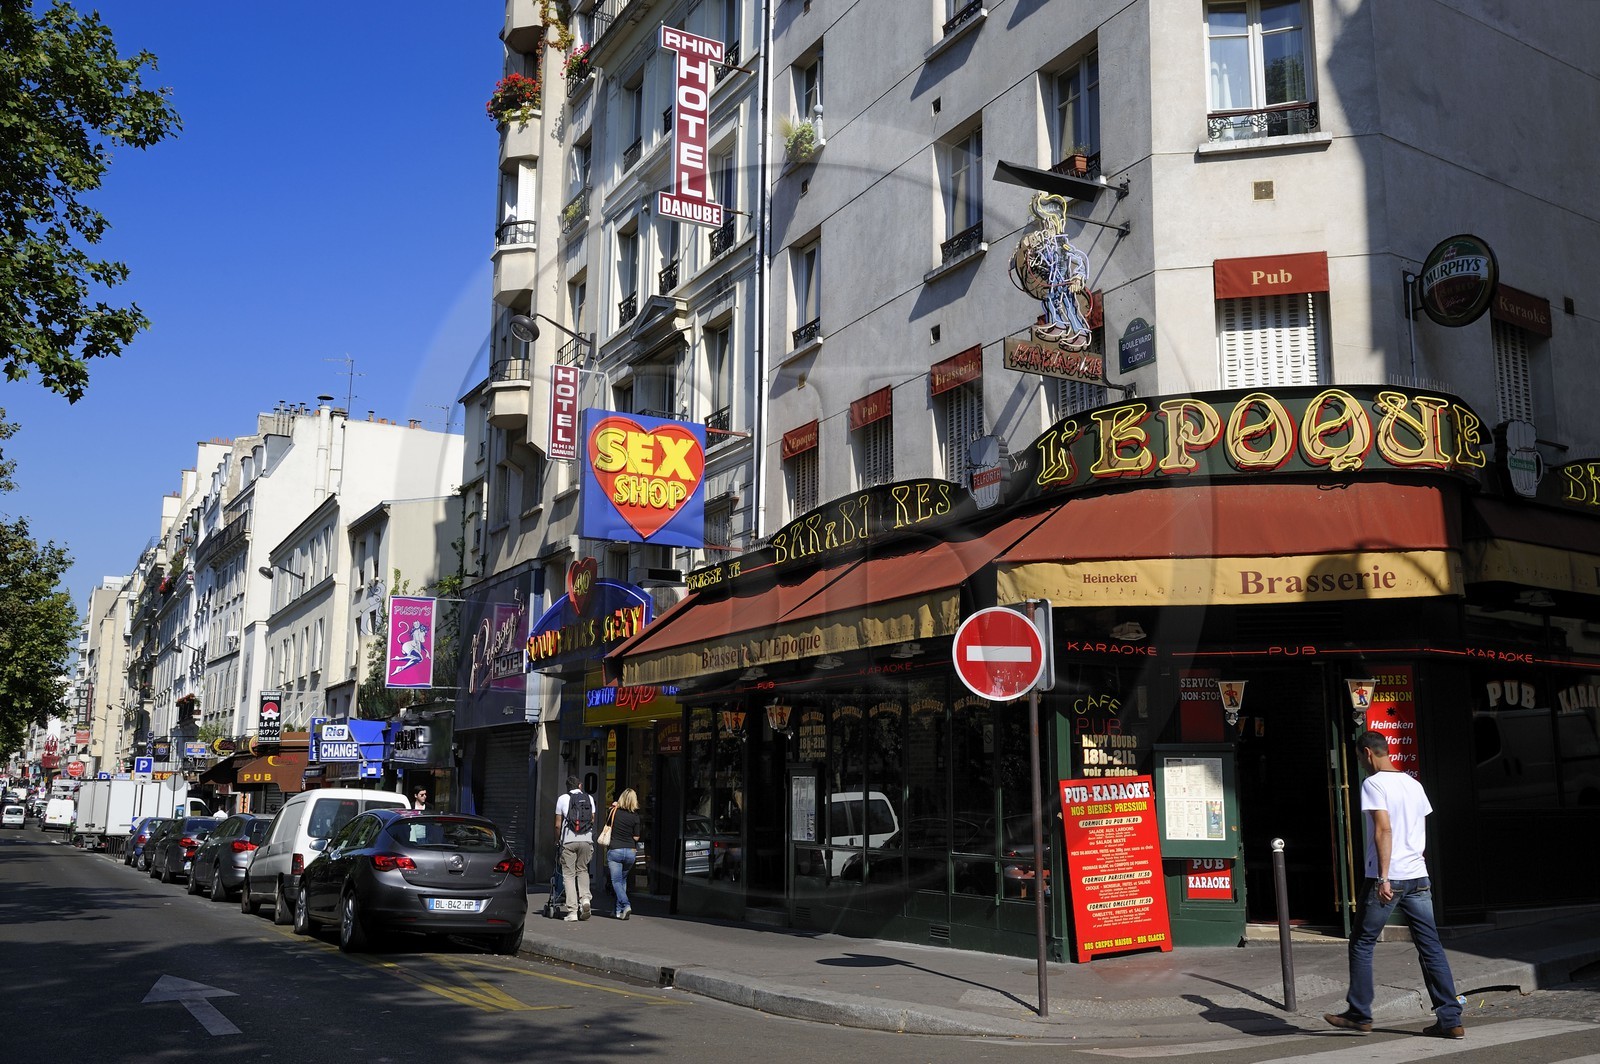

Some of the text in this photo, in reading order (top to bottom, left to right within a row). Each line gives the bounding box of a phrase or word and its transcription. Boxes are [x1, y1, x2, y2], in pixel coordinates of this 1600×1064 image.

[664, 29, 722, 59] RHIN
[678, 56, 708, 198] HOTEL
[661, 196, 720, 224] DANUBE
[1250, 269, 1293, 285] Pub
[1122, 333, 1152, 351] BOULEVARD
[1127, 350, 1147, 364] CLICHY
[935, 359, 977, 387] Brasserie
[556, 368, 575, 442] HOTEL
[862, 402, 878, 419] Pub
[552, 442, 574, 450] RHIN
[594, 427, 697, 482] SEX
[973, 469, 1001, 488] PELFORTH
[613, 474, 687, 510] SHOP
[1083, 572, 1138, 584] Heineken
[1239, 565, 1397, 595] Brasserie
[393, 605, 432, 617] PUSSY'S
[602, 604, 644, 644] SEXY
[759, 633, 821, 660] L'Epoque
[1067, 641, 1158, 656] KARAOKE
[1268, 646, 1317, 656] PUB
[494, 652, 523, 674] HOTEL
[1466, 648, 1534, 664] KARAOKE
[859, 661, 913, 676] KARAOKE
[757, 681, 775, 690] PUB
[1375, 674, 1408, 685] IERES
[1373, 691, 1412, 702] RESSION
[1486, 680, 1537, 710] PUB
[1557, 684, 1600, 714] KARA
[1074, 694, 1122, 715] CAFE
[325, 726, 345, 737] Ria
[1075, 717, 1122, 736] PUB
[1370, 720, 1414, 729] Heineken
[1081, 734, 1137, 748] HAPPY HOURS
[321, 743, 358, 758] CHANGE
[1083, 748, 1136, 765] 18h-21h
[1388, 751, 1417, 762] rphy's
[139, 760, 149, 771] P
[1083, 766, 1102, 777] voir
[243, 773, 272, 782] PUB
[1064, 782, 1150, 804] PUB-KARAOKE
[1070, 801, 1148, 816] NOS BIERES PRESSION
[1081, 819, 1104, 827] FORMULE
[1192, 859, 1224, 870] PUB
[1107, 873, 1135, 881] PARISIENNE
[1188, 876, 1230, 889] KARAOKE
[1113, 899, 1137, 908] OMELETTE
[1084, 942, 1094, 950] NOS
[1095, 940, 1113, 949] CREPES
[1114, 937, 1133, 947] MAISON
[1147, 933, 1165, 942] GLACES
